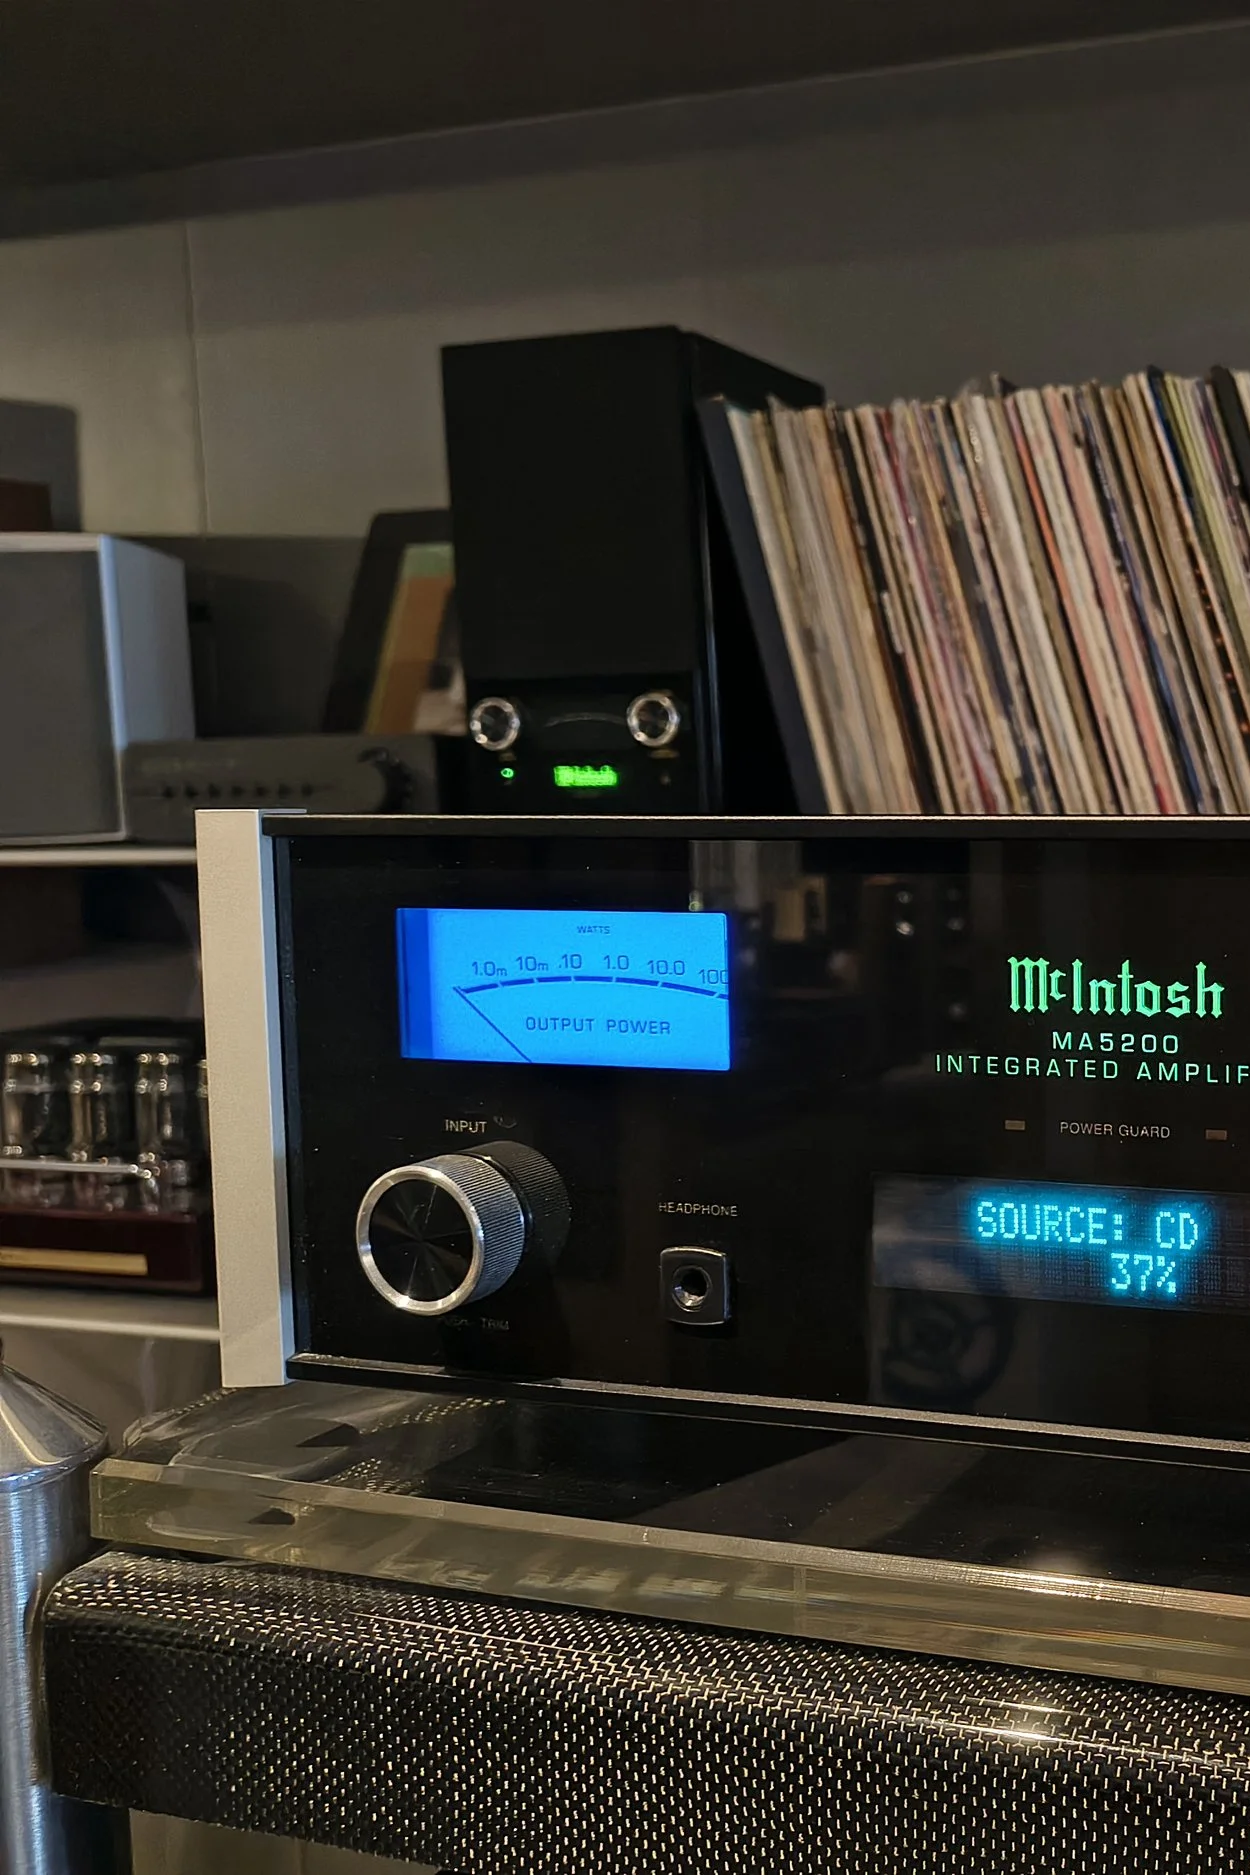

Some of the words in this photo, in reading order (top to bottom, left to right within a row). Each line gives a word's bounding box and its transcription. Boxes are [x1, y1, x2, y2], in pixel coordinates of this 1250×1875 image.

[576, 925, 611, 935] WATTS
[515, 956, 549, 972] 10m
[604, 954, 630, 970] 1.0
[646, 959, 686, 976] 10.0
[1006, 956, 1225, 1019] McIntosh
[525, 1016, 595, 1032] OUTPUT
[606, 1019, 671, 1035] POWER
[1052, 1031, 1180, 1054] MA5200
[935, 1054, 1119, 1079] INTEGRATED
[444, 1119, 488, 1134] INPUT
[1060, 1121, 1113, 1136] POWER
[1118, 1124, 1171, 1139] GUARD
[658, 1201, 739, 1217] HEADPHONE
[976, 1201, 1124, 1246] SOURCE:
[1155, 1211, 1199, 1251] CD
[1110, 1252, 1177, 1294] 37%
